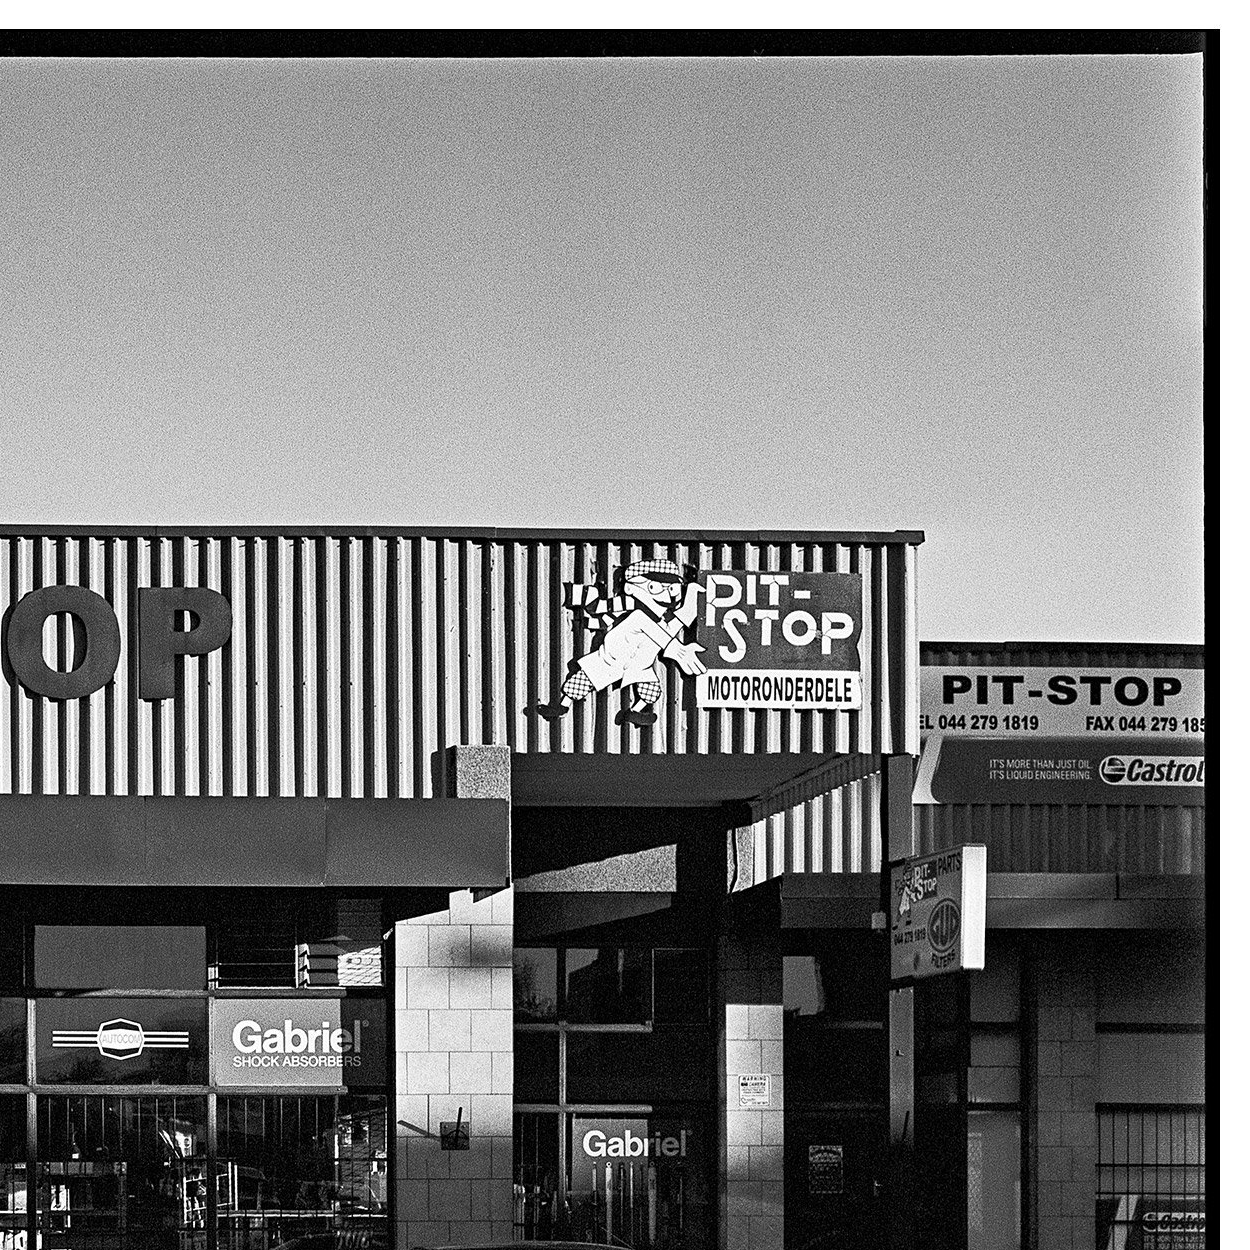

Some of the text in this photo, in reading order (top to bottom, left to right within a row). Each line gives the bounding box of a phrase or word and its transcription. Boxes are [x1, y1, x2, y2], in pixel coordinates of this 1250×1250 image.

[706, 574, 811, 627] PIT-
[718, 608, 854, 664] STOP
[707, 675, 853, 703] MOTORONDERDELE
[942, 674, 1183, 707] PIT-STOP
[919, 715, 1039, 731] EL 044 279 1819
[1085, 715, 1115, 731] FAX
[1118, 716, 1146, 732] 044
[1150, 716, 1178, 732] 279
[989, 759, 1005, 769] IT'S
[1006, 759, 1031, 769] MORE
[1032, 759, 1055, 769] THAN
[1055, 759, 1077, 769] JUST
[989, 770, 1093, 780] IT'S LIQUID ENGINEERING.
[1125, 758, 1205, 783] Castrol
[938, 852, 961, 876] PARTS
[917, 877, 937, 900] STOP
[102, 1033, 140, 1044] AUTOCOM
[232, 1019, 361, 1054] Gabriel
[233, 1055, 362, 1068] SHOCK ABSORBERS
[582, 1129, 687, 1157] Gabriel
